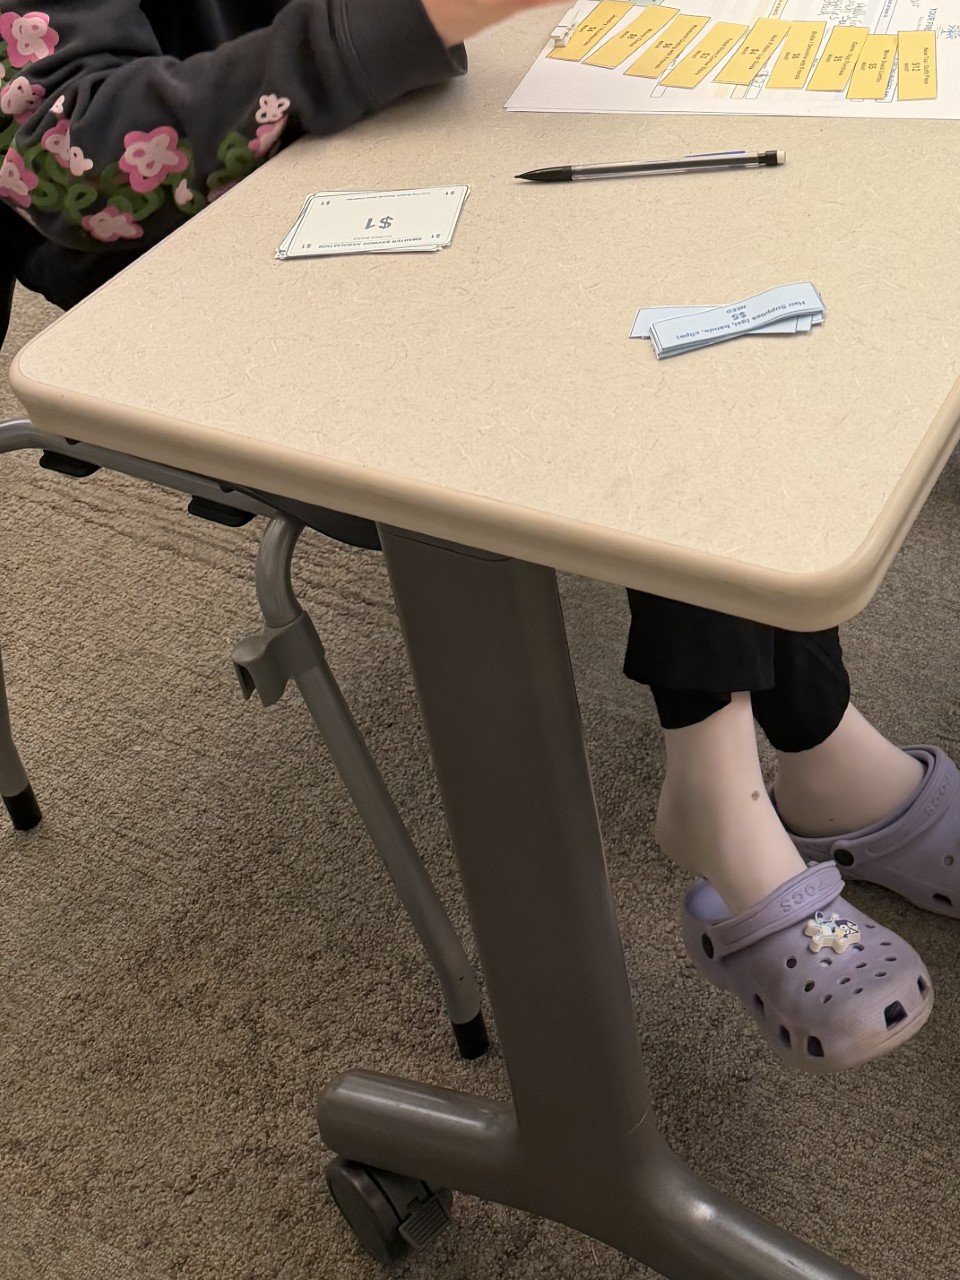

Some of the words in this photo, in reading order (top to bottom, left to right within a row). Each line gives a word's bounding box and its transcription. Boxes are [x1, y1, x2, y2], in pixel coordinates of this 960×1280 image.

[911, 62, 920, 72] $12
[364, 216, 394, 230] $1
[726, 305, 746, 314] NEED
[788, 300, 806, 308] Hair
[731, 311, 746, 320] $5
[751, 305, 787, 321] Supplies
[732, 317, 750, 328] (gel,
[701, 323, 731, 334] bands,
[675, 329, 700, 340] clips)
